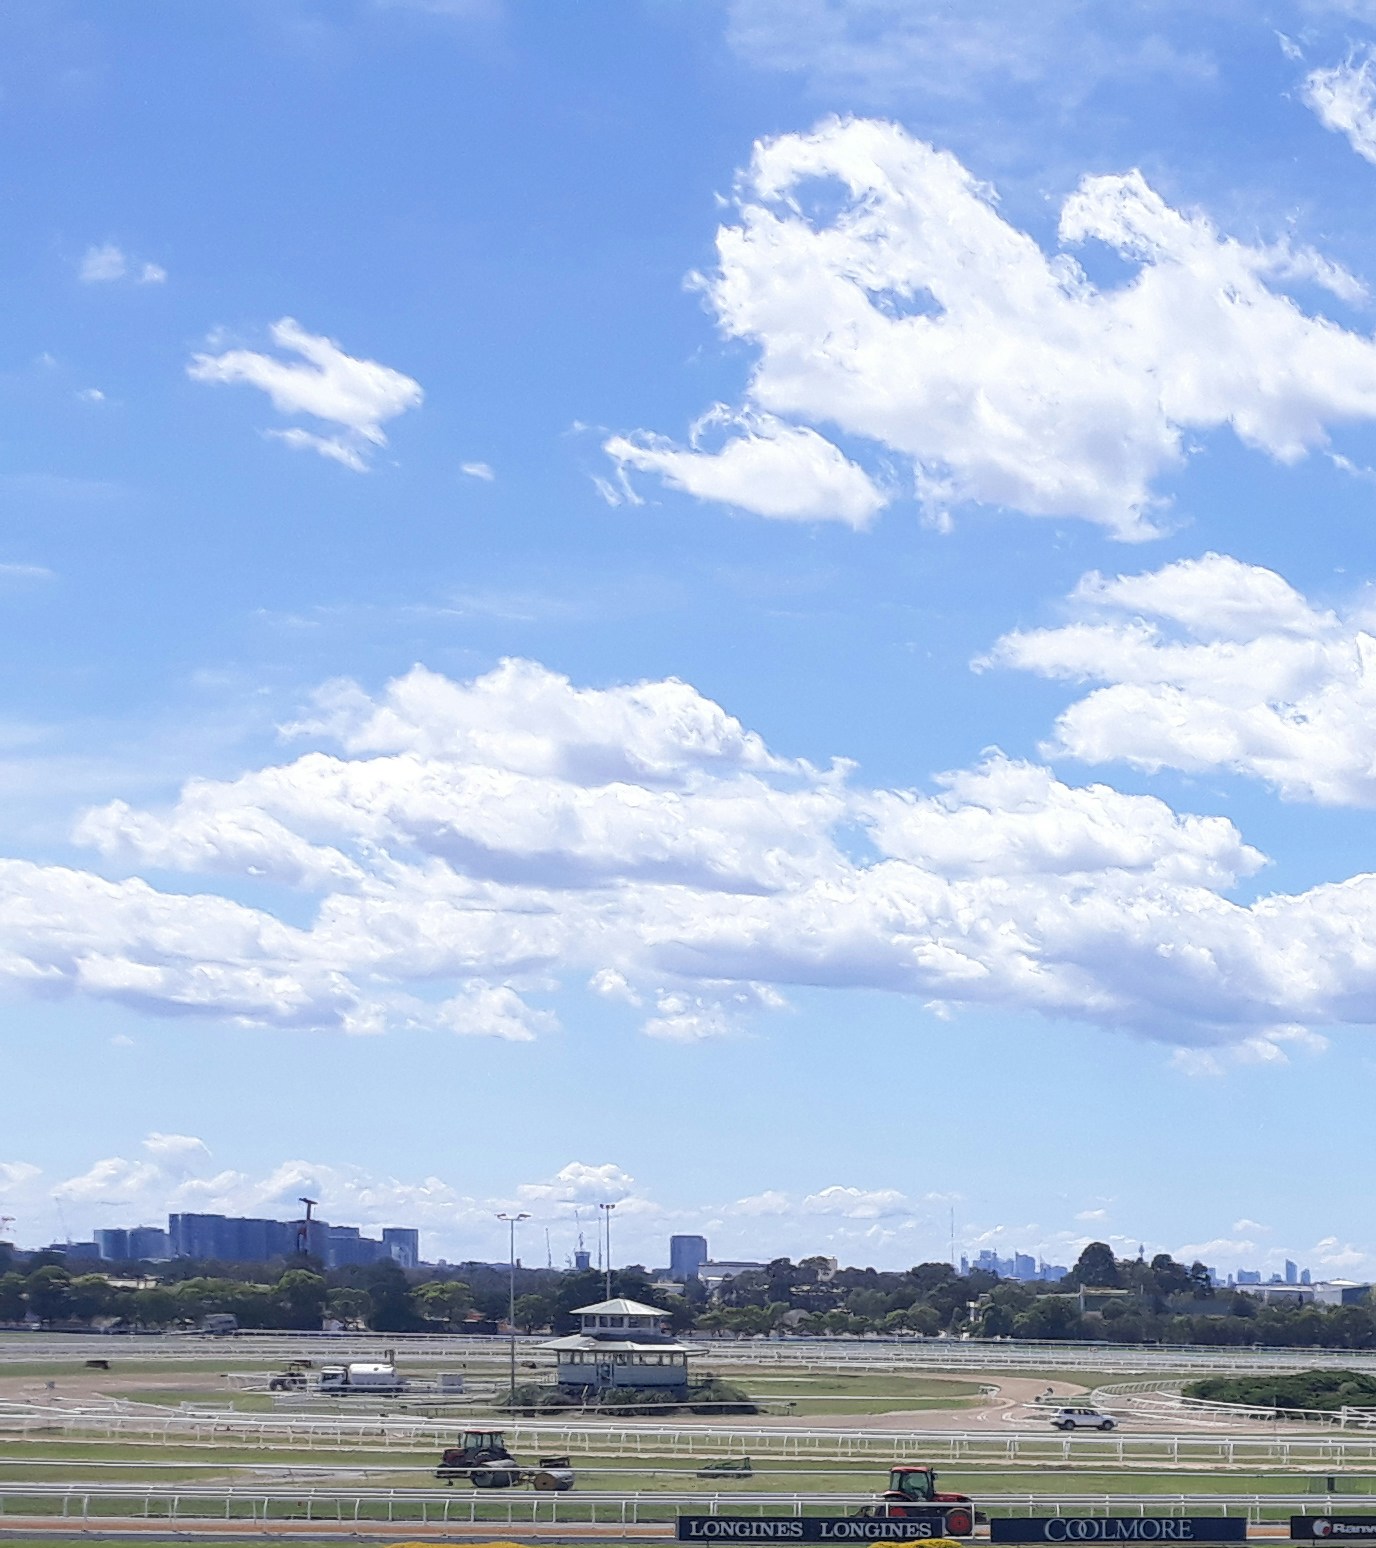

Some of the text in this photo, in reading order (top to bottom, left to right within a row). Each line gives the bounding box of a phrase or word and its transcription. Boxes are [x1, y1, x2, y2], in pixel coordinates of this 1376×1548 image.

[689, 1520, 803, 1538] LONGINES
[819, 1521, 932, 1538] LONGINES
[1044, 1518, 1195, 1541] COOLMORE
